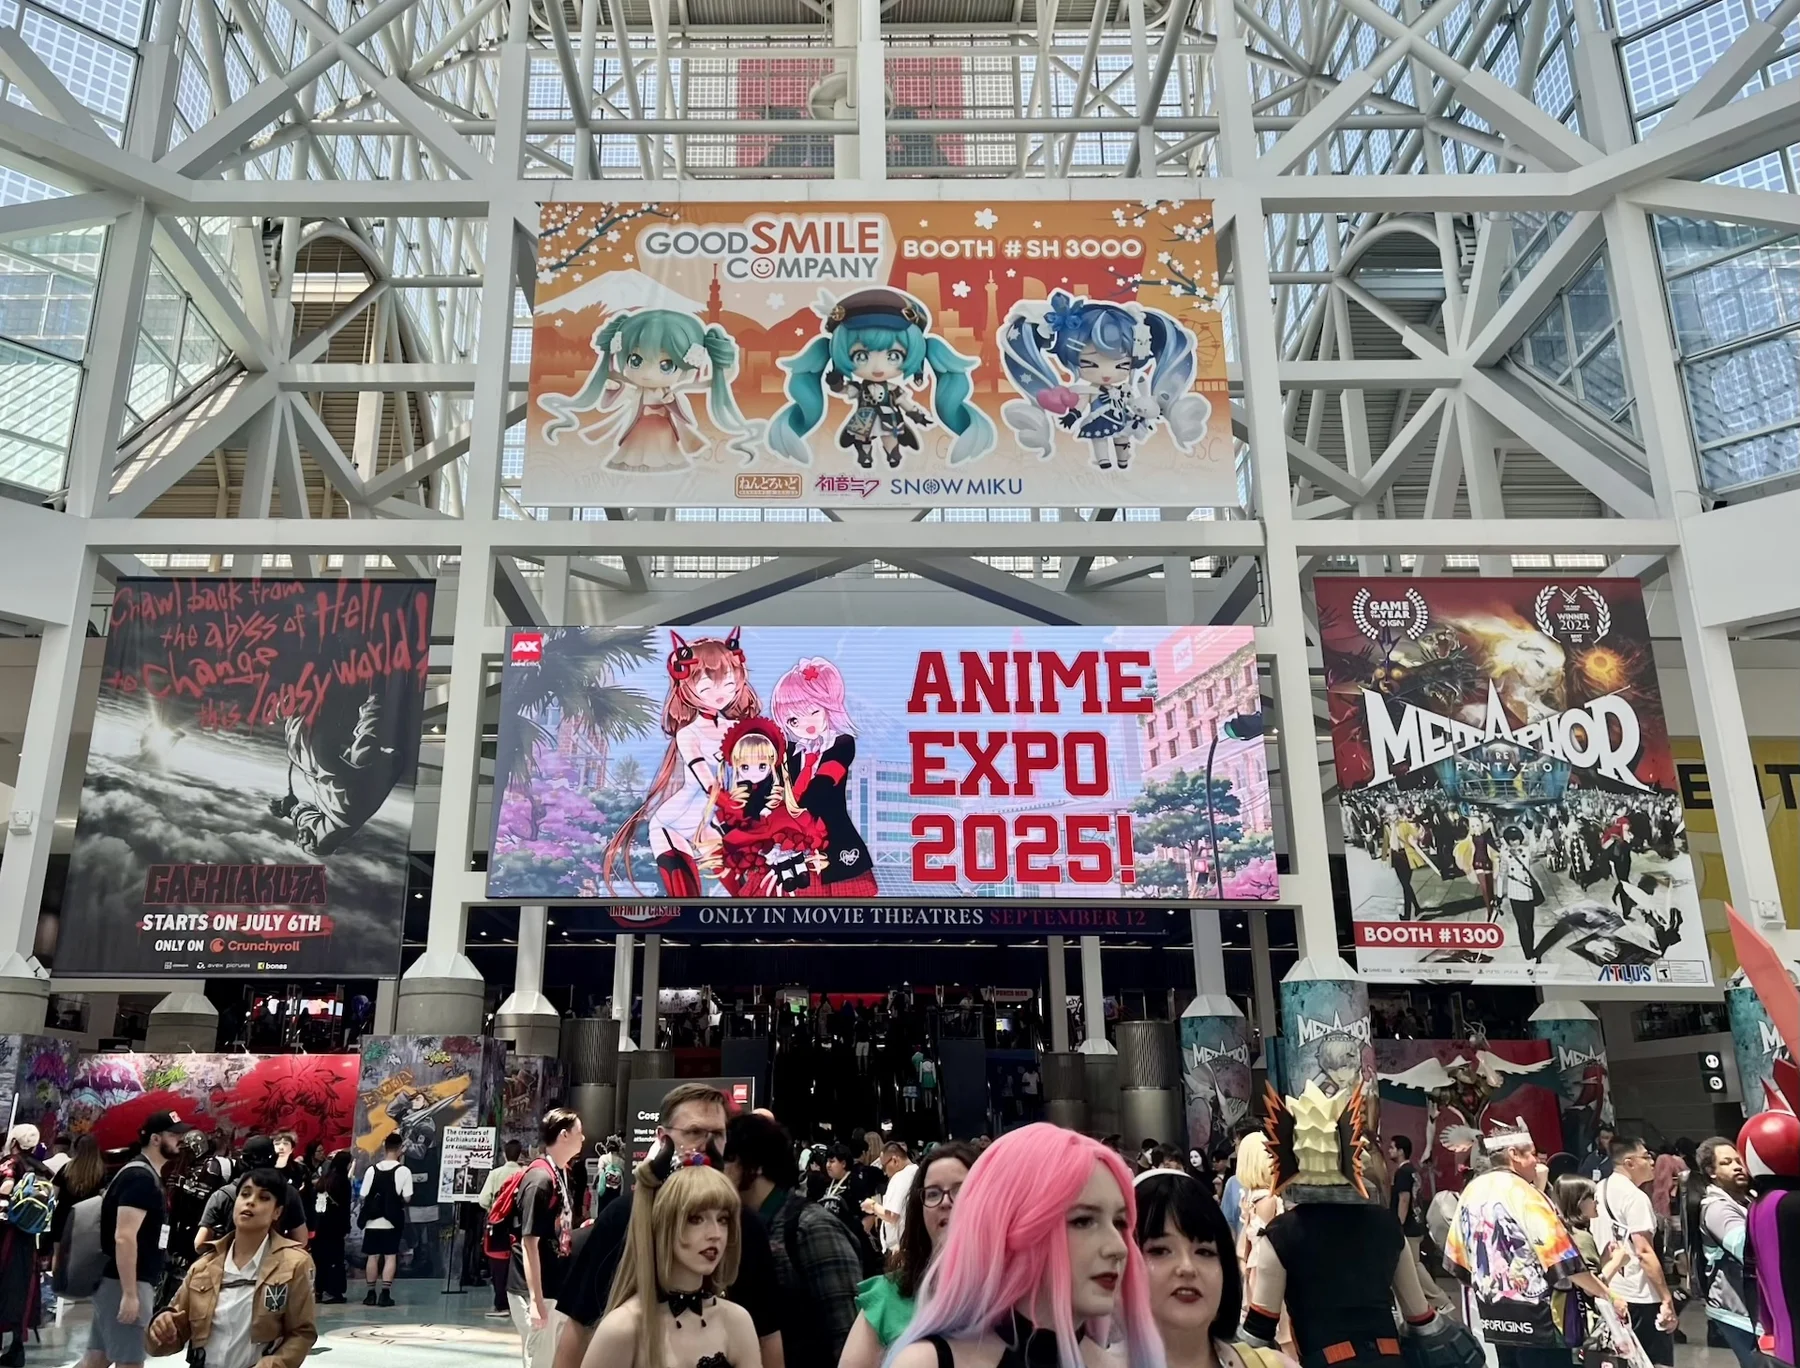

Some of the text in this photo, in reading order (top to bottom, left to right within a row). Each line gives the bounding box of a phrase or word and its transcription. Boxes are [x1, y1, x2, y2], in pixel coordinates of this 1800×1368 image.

[645, 220, 879, 255] GOOD SMILE
[903, 239, 994, 258] BOOTH
[815, 475, 880, 498] 初音ミク
[890, 478, 1023, 495] SNOW MIKU
[187, 577, 243, 614] back
[248, 580, 305, 603] from
[160, 578, 383, 652] the abyss of Hell
[1369, 601, 1410, 611] GAME
[1380, 610, 1411, 619] YEAR
[1387, 619, 1405, 627] IGN
[1559, 620, 1591, 631] 2024
[512, 640, 541, 652] AX
[107, 648, 278, 698] to Change
[907, 650, 1154, 714] ANIME
[195, 698, 241, 731] this
[247, 661, 331, 728] lousy
[1357, 678, 1658, 795] METAPHOR
[908, 730, 1110, 797] EXPO
[1495, 752, 1510, 761] RE
[1455, 761, 1553, 774] FANTAZIO
[910, 813, 1137, 885] 2025!
[143, 864, 328, 905] GACHIAKUTA
[650, 904, 681, 917] CASTLE
[699, 907, 1147, 926] ONLY IN MOVIE THEATRES SEPTEMBER 12
[142, 913, 322, 932] STARTS ON JULY 6TH
[1363, 926, 1500, 944] BOOTH #1300
[154, 939, 301, 954] ONLY ON Crunchyroll
[265, 962, 288, 970] bones
[1597, 964, 1652, 982] ATLUS
[637, 1110, 660, 1122] Cosp
